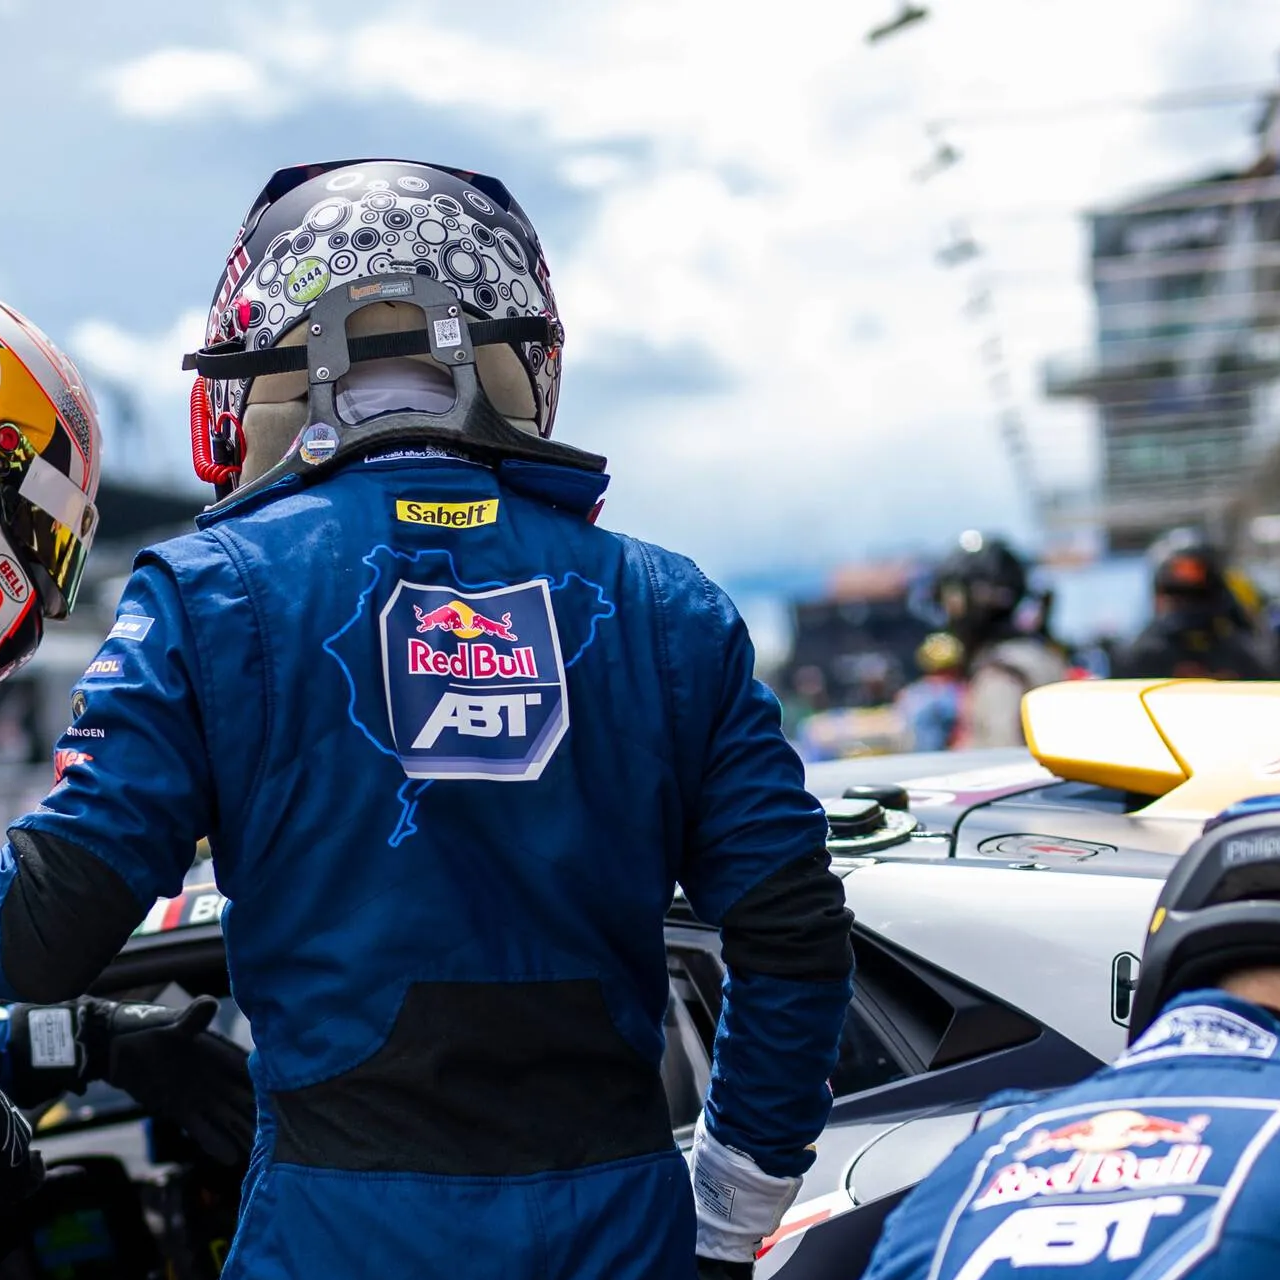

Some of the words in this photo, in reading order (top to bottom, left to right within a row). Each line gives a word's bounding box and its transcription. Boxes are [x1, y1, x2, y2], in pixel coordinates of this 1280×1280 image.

[292, 266, 322, 292] 0344
[406, 502, 486, 527] Sabelt
[0, 560, 24, 597] BELL
[408, 638, 470, 678] Red
[470, 644, 538, 679] Bull
[411, 692, 542, 749] ABT
